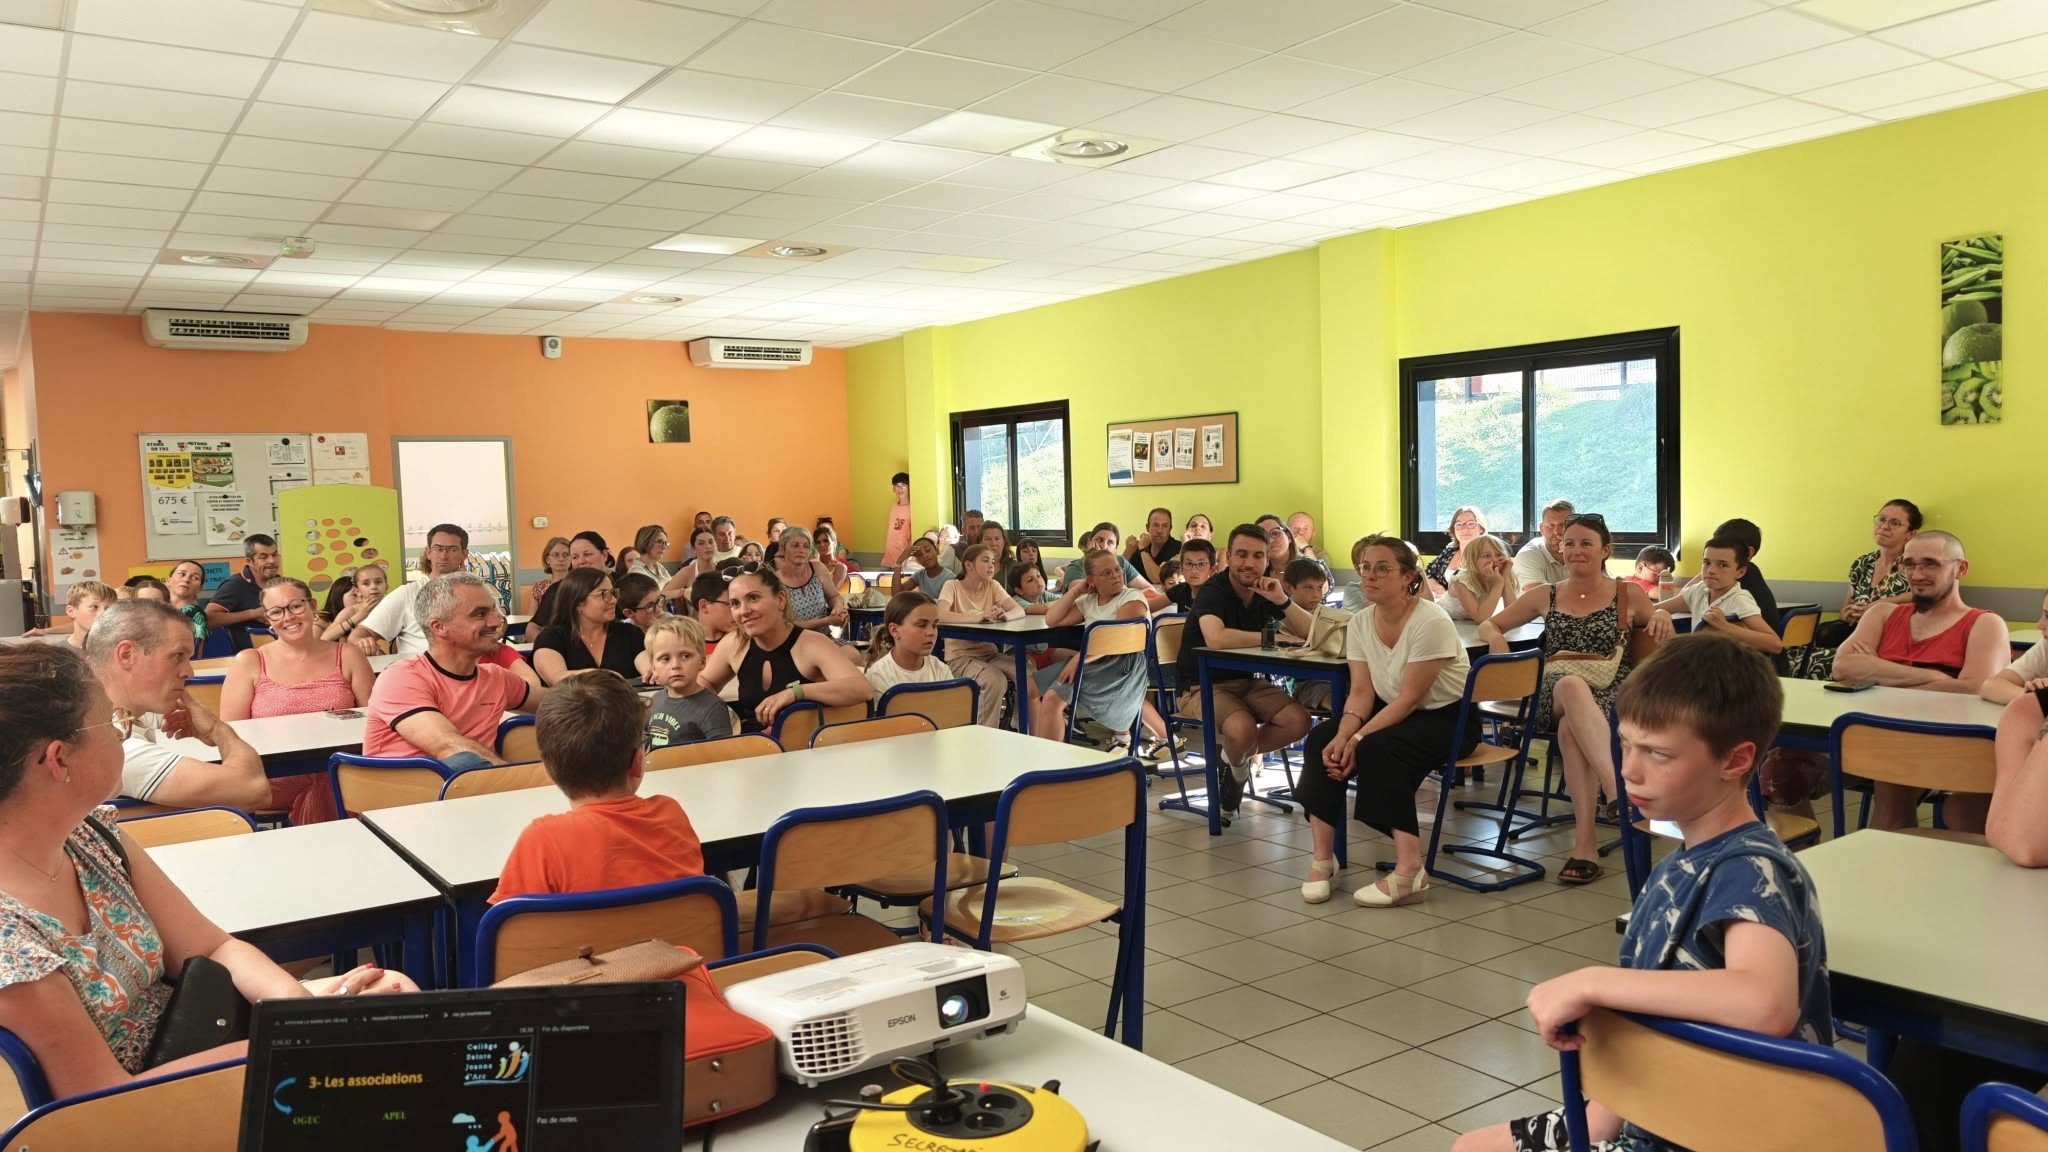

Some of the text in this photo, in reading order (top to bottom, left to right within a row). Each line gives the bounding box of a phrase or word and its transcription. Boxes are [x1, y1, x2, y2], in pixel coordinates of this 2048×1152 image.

[158, 496, 188, 505] 675 €
[887, 1013, 916, 1028] EPSON
[560, 1023, 590, 1032] diaporama
[467, 1042, 498, 1051] Collège
[464, 1063, 493, 1071] Jeanne
[308, 1072, 423, 1089] 3- Les associations
[464, 1073, 487, 1081] d'Arc
[292, 1115, 321, 1125] OGEC
[382, 1111, 407, 1121] APEL
[536, 1116, 548, 1124] Pas
[549, 1116, 558, 1124] de
